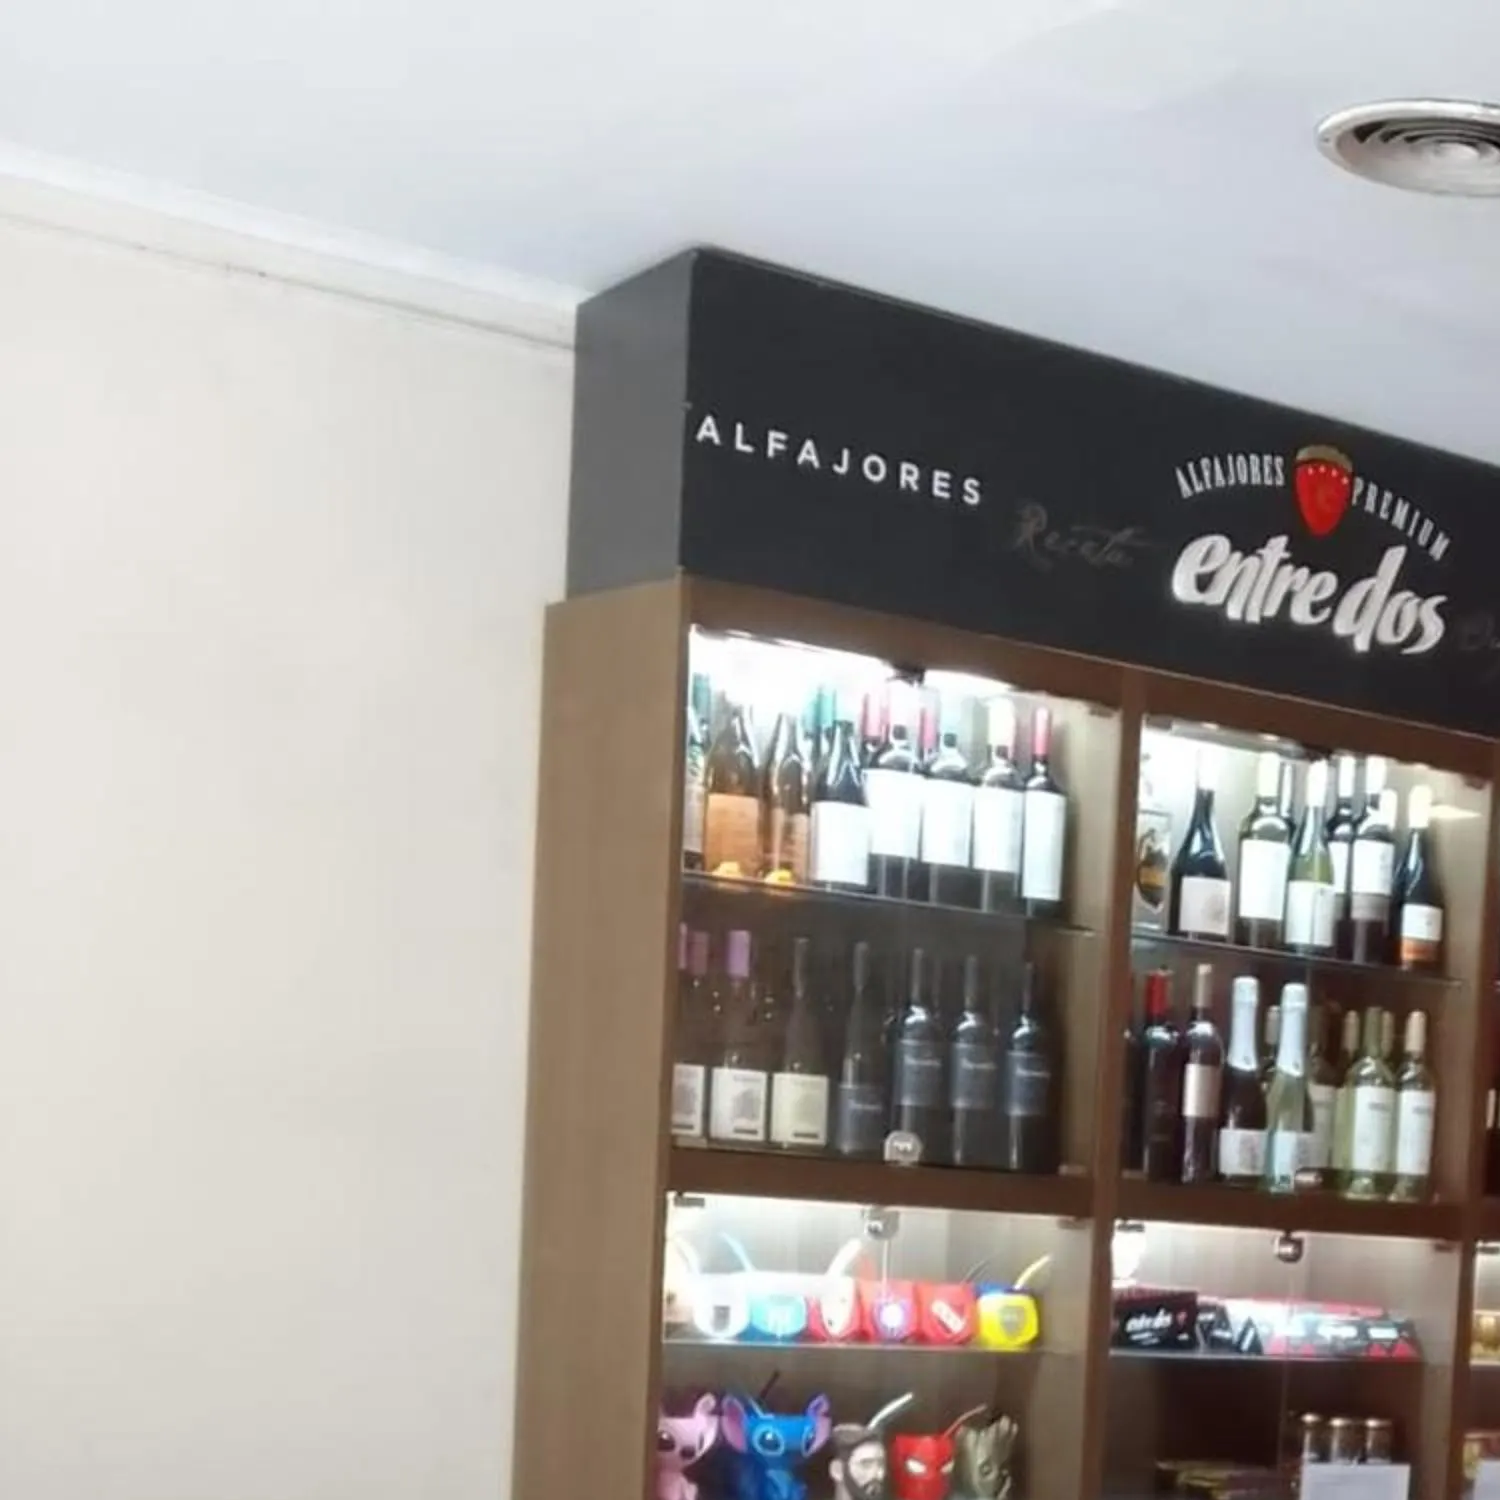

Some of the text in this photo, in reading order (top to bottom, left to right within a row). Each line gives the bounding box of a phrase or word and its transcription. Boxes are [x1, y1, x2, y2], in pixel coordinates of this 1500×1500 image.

[695, 414, 983, 506] ALFAJORES
[1174, 453, 1451, 562] ALFAJORES PREMIUM
[1171, 533, 1339, 625] entre
[1331, 545, 1450, 655] dos
